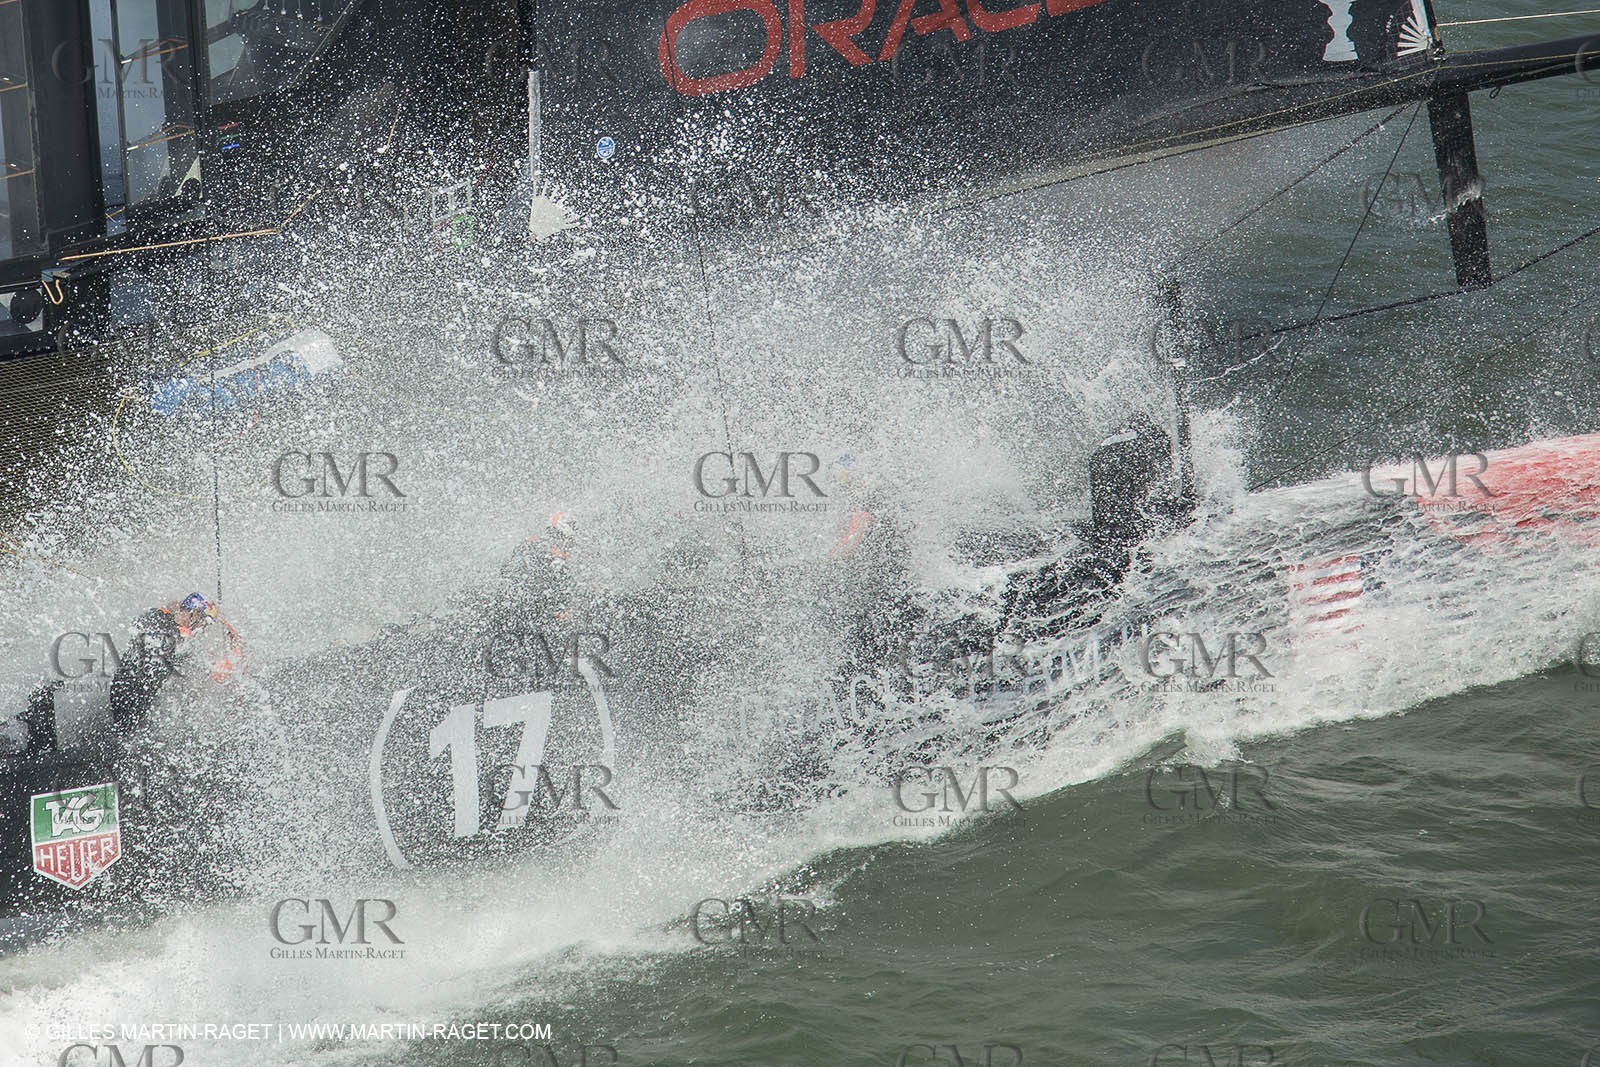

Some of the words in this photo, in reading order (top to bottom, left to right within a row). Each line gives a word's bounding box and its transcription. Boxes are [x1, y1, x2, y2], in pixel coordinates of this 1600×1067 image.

[429, 690, 552, 838] 17
[45, 796, 106, 838] TAG
[40, 837, 115, 883] HEUER
